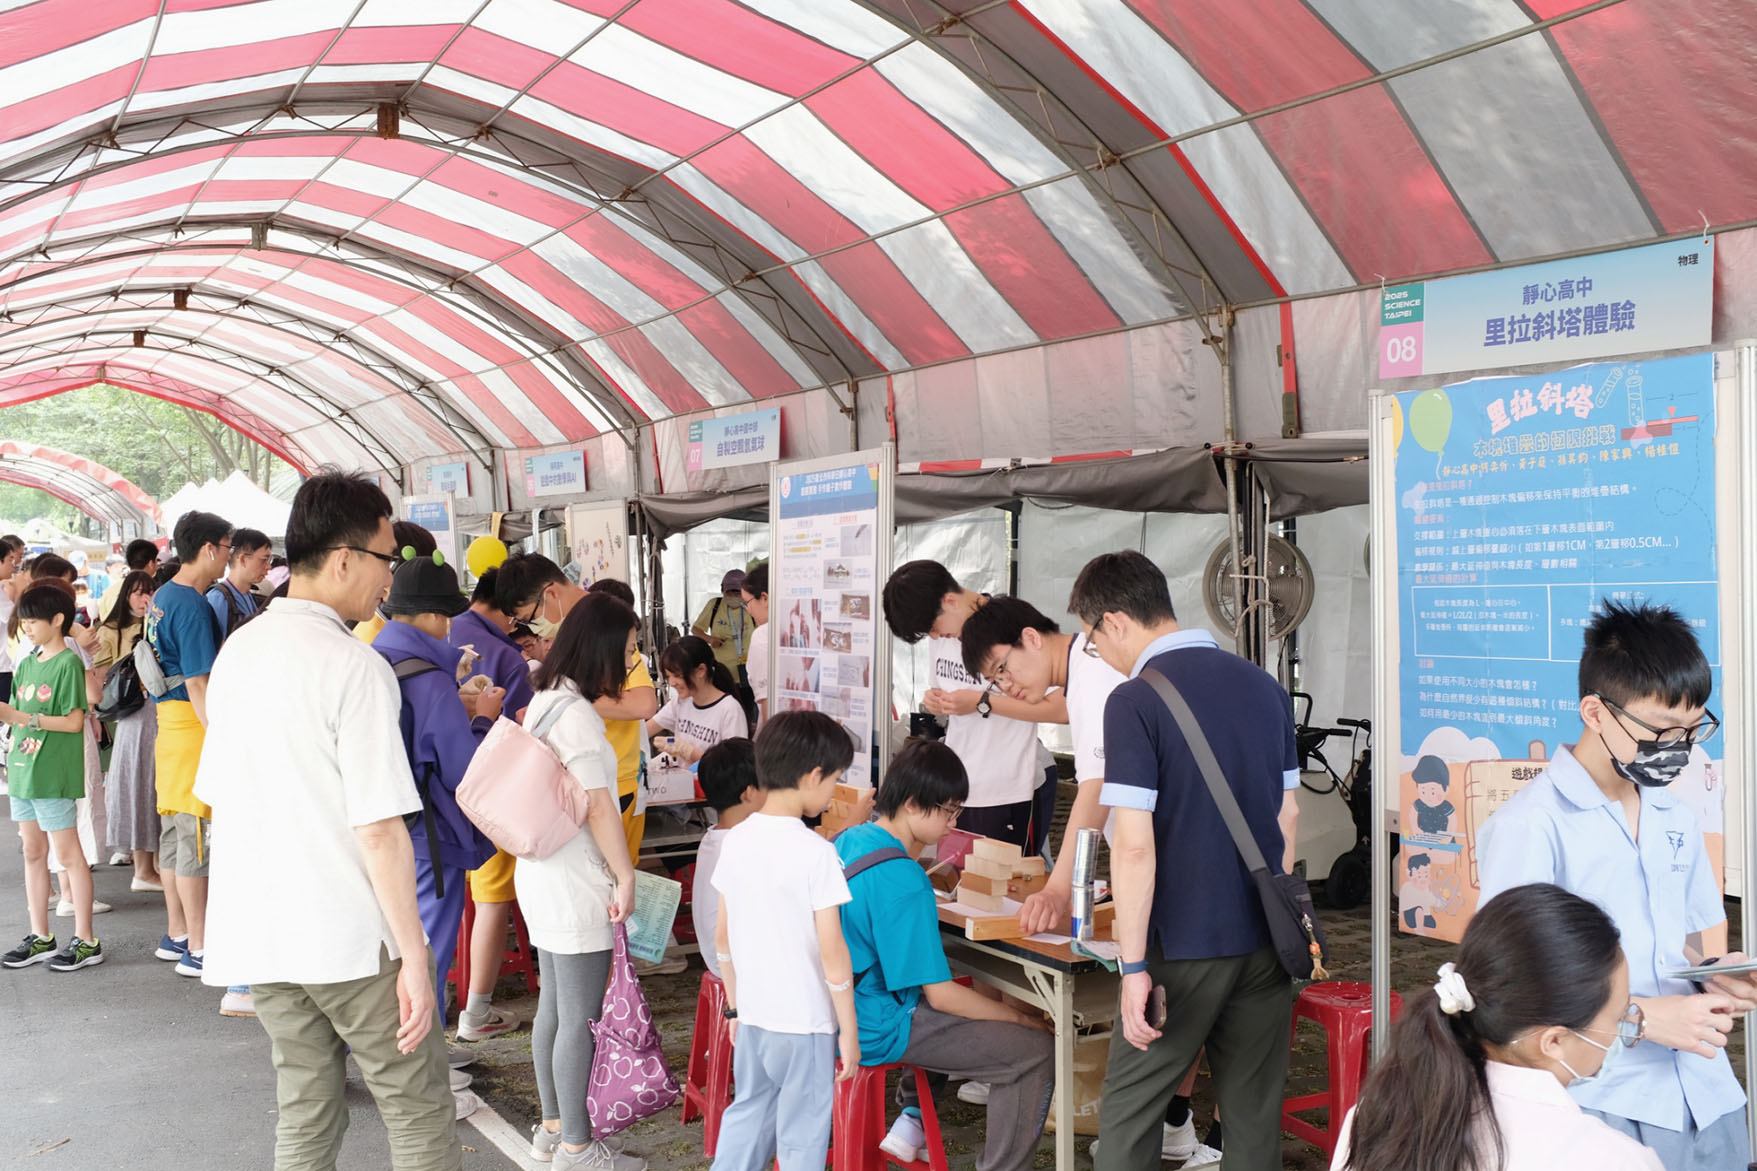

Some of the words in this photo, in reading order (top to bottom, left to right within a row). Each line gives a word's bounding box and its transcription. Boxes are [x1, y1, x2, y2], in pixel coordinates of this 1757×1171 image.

[1678, 253, 1699, 267] 物理
[1384, 291, 1408, 300] 2025
[1523, 276, 1593, 305] 靜心高中
[1384, 299, 1421, 310] SCIENCE
[1385, 310, 1412, 319] TAIPEI
[1484, 300, 1636, 347] 里拉斜塔體驗
[1387, 336, 1416, 364] 08
[1486, 382, 1595, 435] 里拉斜塔
